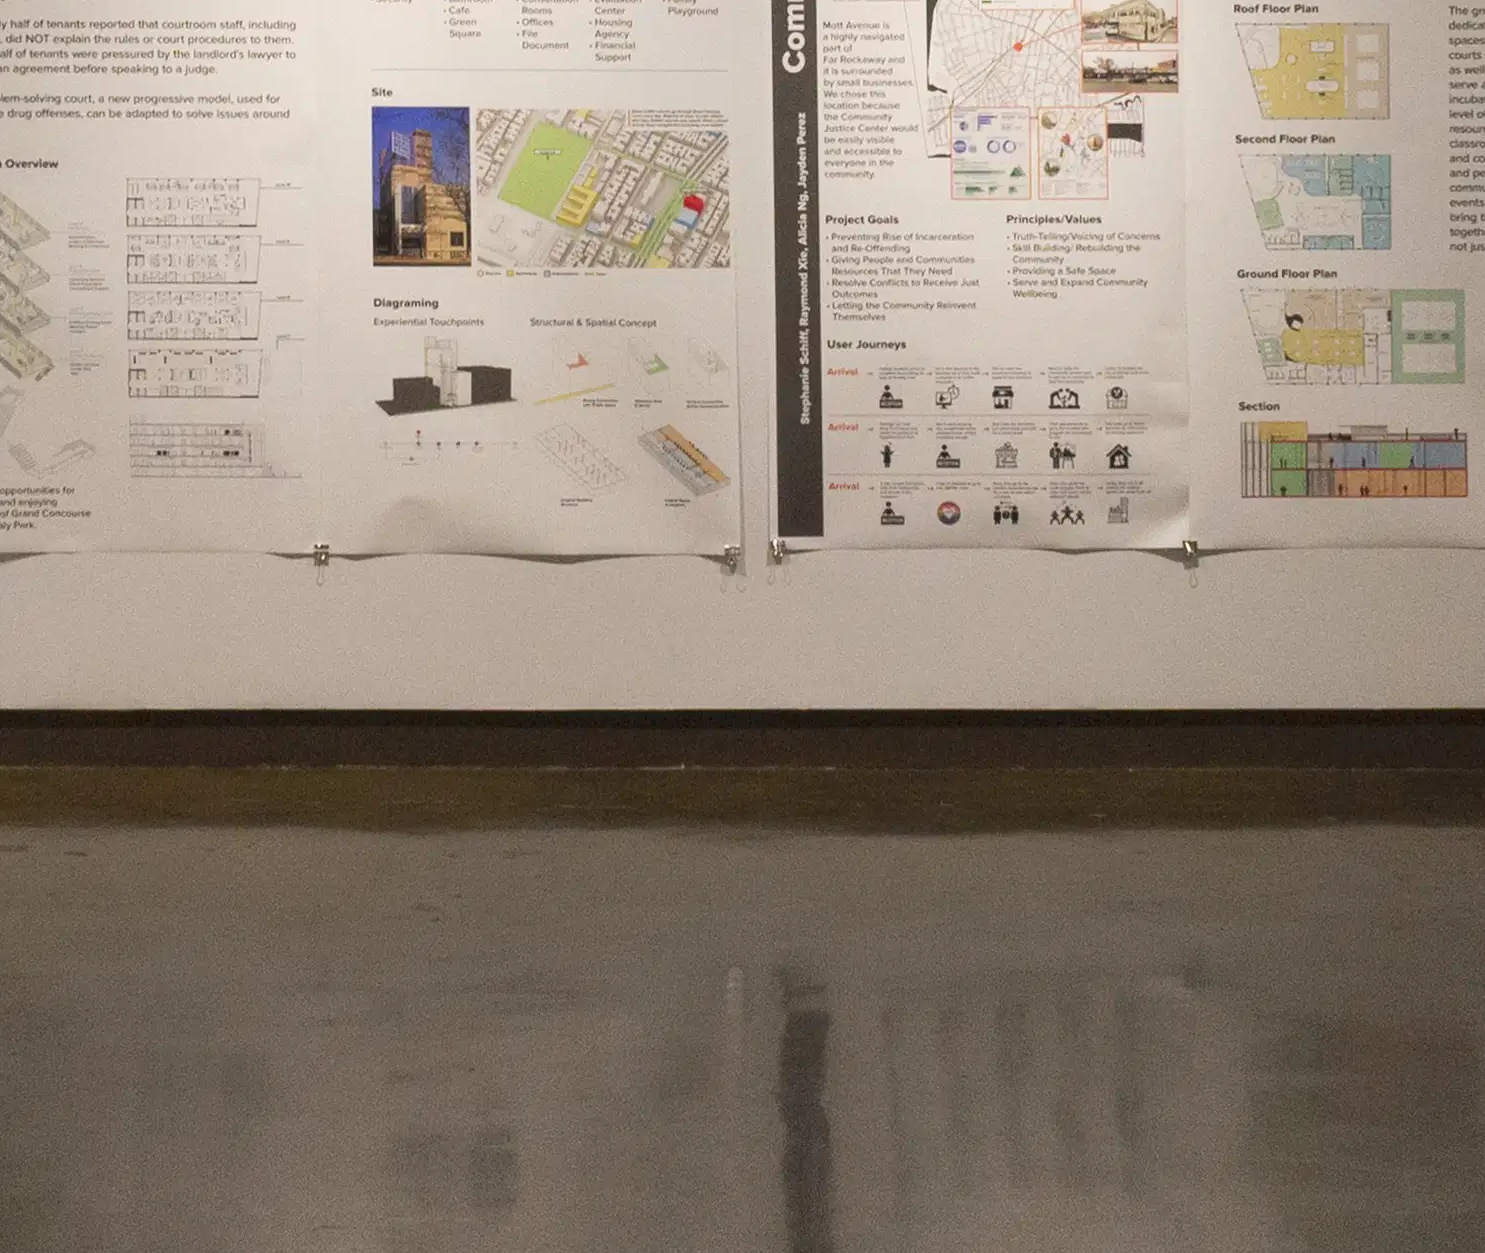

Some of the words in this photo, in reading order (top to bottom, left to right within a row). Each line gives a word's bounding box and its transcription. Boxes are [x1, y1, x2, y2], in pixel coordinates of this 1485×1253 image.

[668, 7, 719, 17] Playground
[1234, 4, 1259, 13] Roof
[1263, 4, 1290, 13] Floor
[1294, 4, 1319, 13] Plan
[372, 88, 392, 96] Site
[1235, 135, 1276, 144] Second
[1279, 134, 1307, 143] Floor
[1311, 134, 1335, 143] Plan
[5, 159, 58, 168] Overview
[825, 215, 864, 226] Project
[868, 215, 899, 224] Goals
[1006, 215, 1102, 225] Principles/Values
[1237, 269, 1278, 278] Ground
[1282, 269, 1309, 278] Floor
[1313, 269, 1337, 278] Plan
[373, 298, 439, 309] Diagraming
[530, 318, 574, 326] Structural
[576, 318, 582, 326] &
[618, 319, 656, 328] Concept
[827, 340, 852, 349] User
[857, 340, 906, 351] Journeys
[1239, 402, 1280, 411] Section
